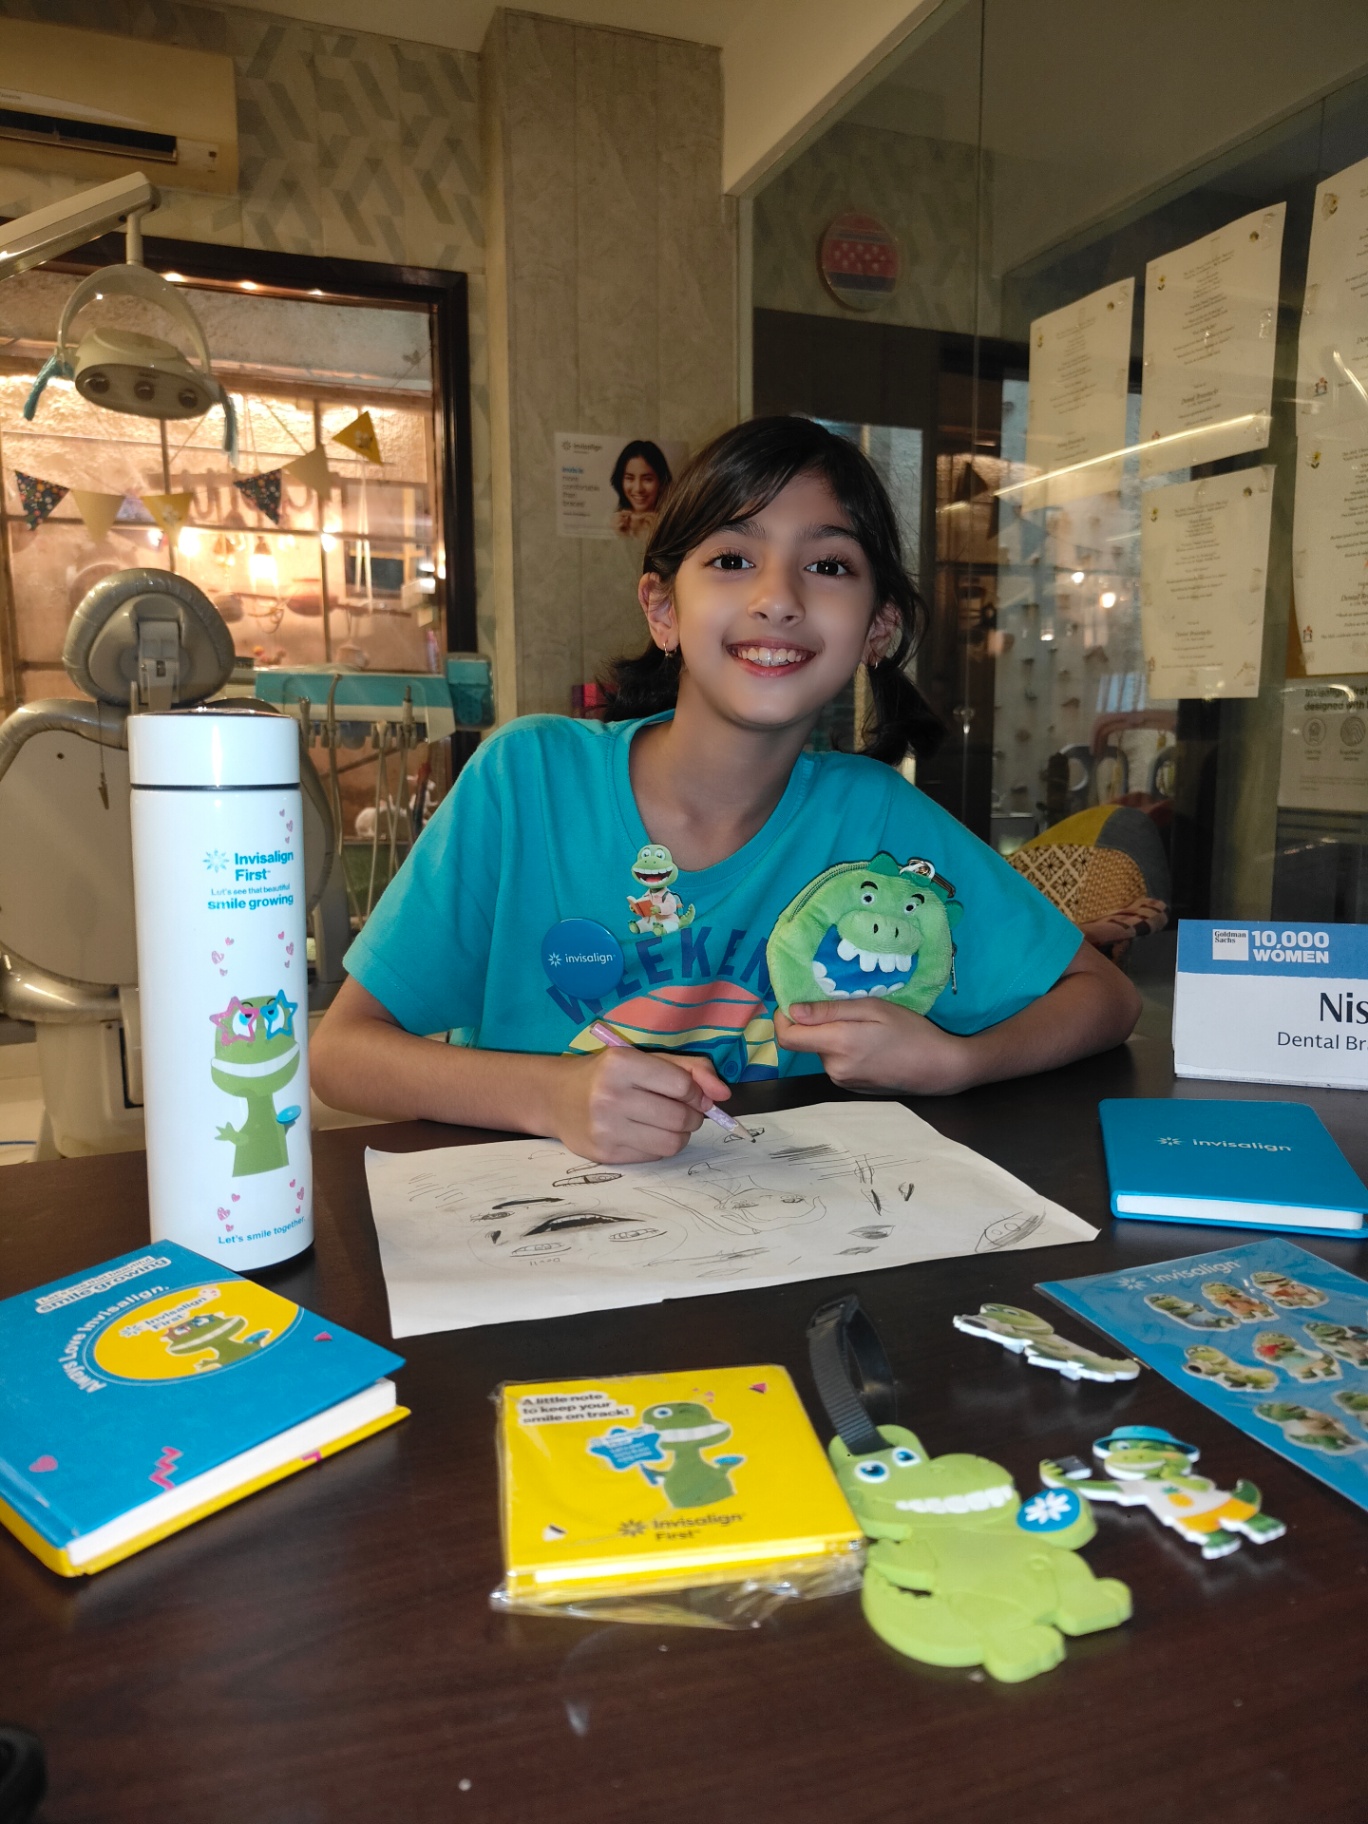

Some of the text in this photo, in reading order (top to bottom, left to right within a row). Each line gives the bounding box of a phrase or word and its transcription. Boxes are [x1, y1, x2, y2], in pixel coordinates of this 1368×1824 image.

[234, 850, 294, 865] Invisalign
[235, 868, 267, 881] First
[248, 886, 262, 894] that
[263, 883, 291, 893] beautiful
[207, 894, 294, 910] smile growing
[1214, 930, 1247, 938] Goldman
[1251, 930, 1330, 949] 10,000
[564, 952, 613, 964] invisalign
[1252, 949, 1330, 964] WOMEN
[1278, 1031, 1368, 1051] Dental Br
[1193, 1138, 1292, 1152] invisalign
[217, 1234, 244, 1244] Let's
[246, 1229, 272, 1241] smile
[1146, 1259, 1241, 1284] invisalign
[40, 1259, 168, 1311] smile growing
[58, 1333, 87, 1362] Love
[536, 1396, 568, 1405] little
[570, 1393, 603, 1402] note
[540, 1405, 577, 1413] keep
[579, 1402, 611, 1411] your
[653, 1514, 743, 1529] Invisalign
